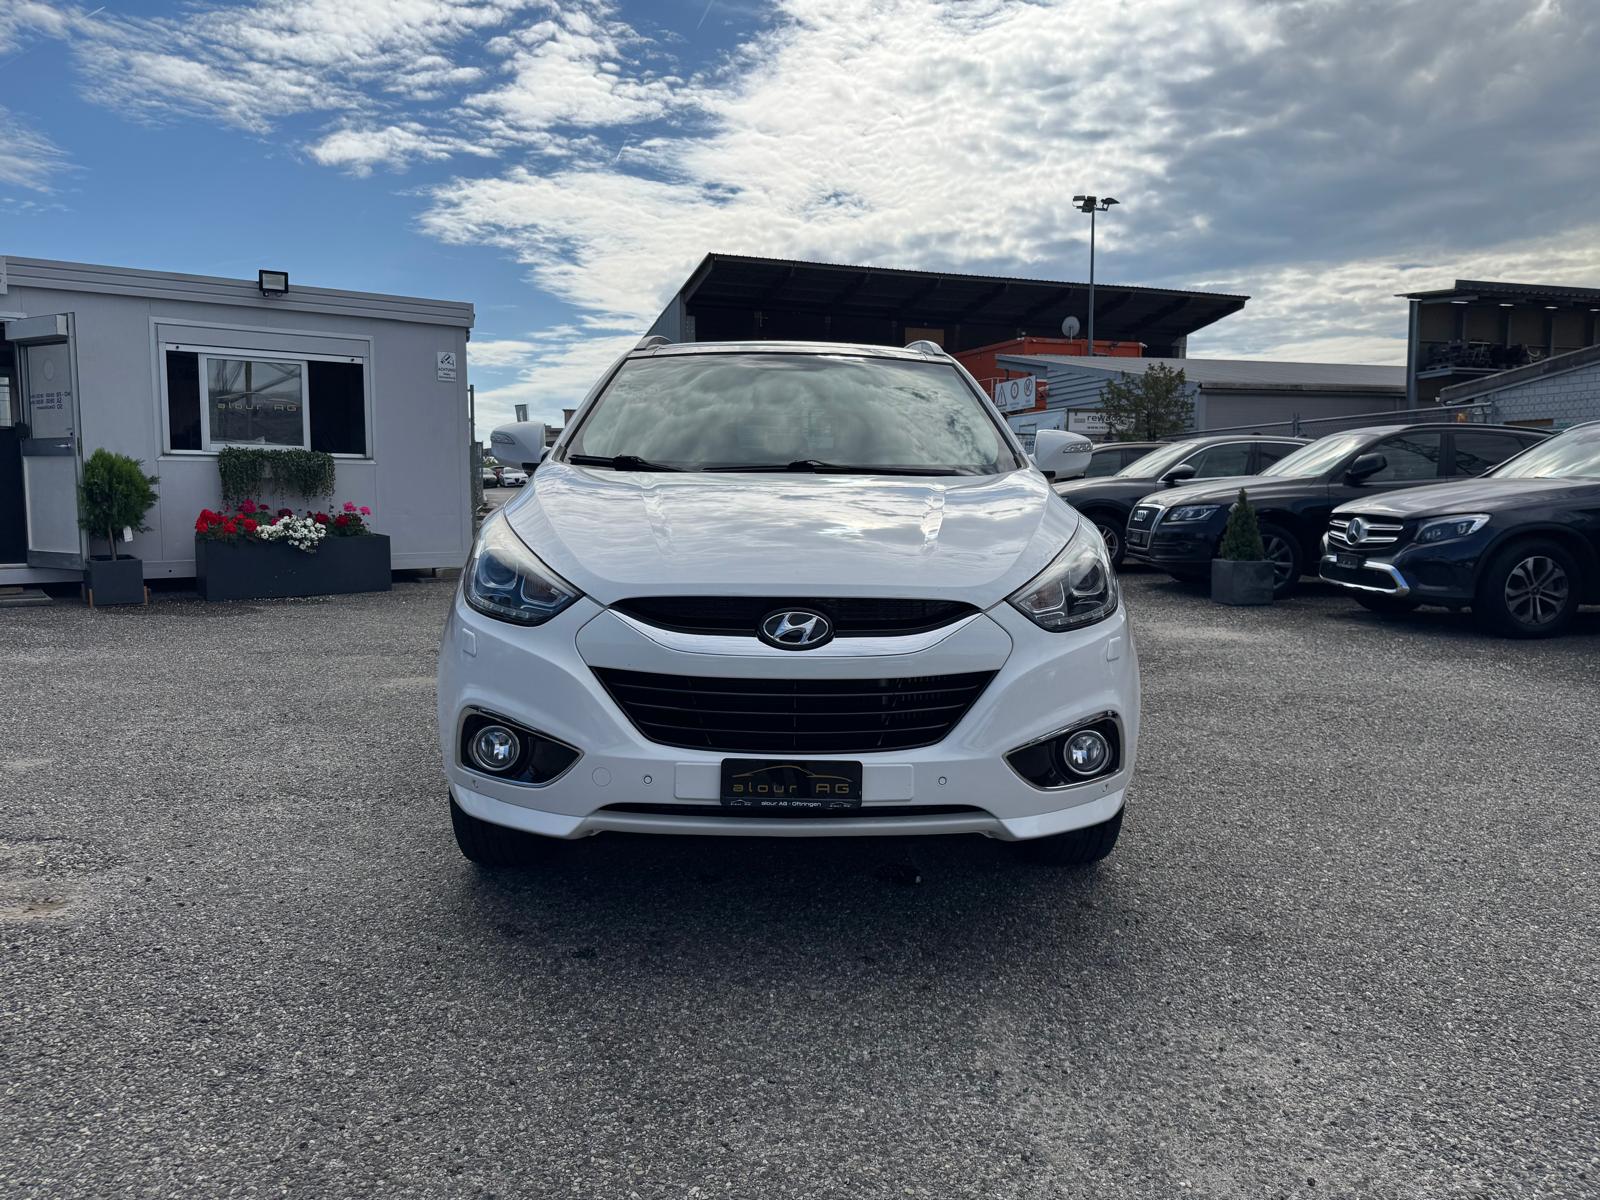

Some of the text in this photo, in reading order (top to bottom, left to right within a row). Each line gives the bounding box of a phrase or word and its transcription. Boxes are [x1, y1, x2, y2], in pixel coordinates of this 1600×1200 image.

[274, 403, 297, 412] AG
[732, 782, 850, 794] alour AG
